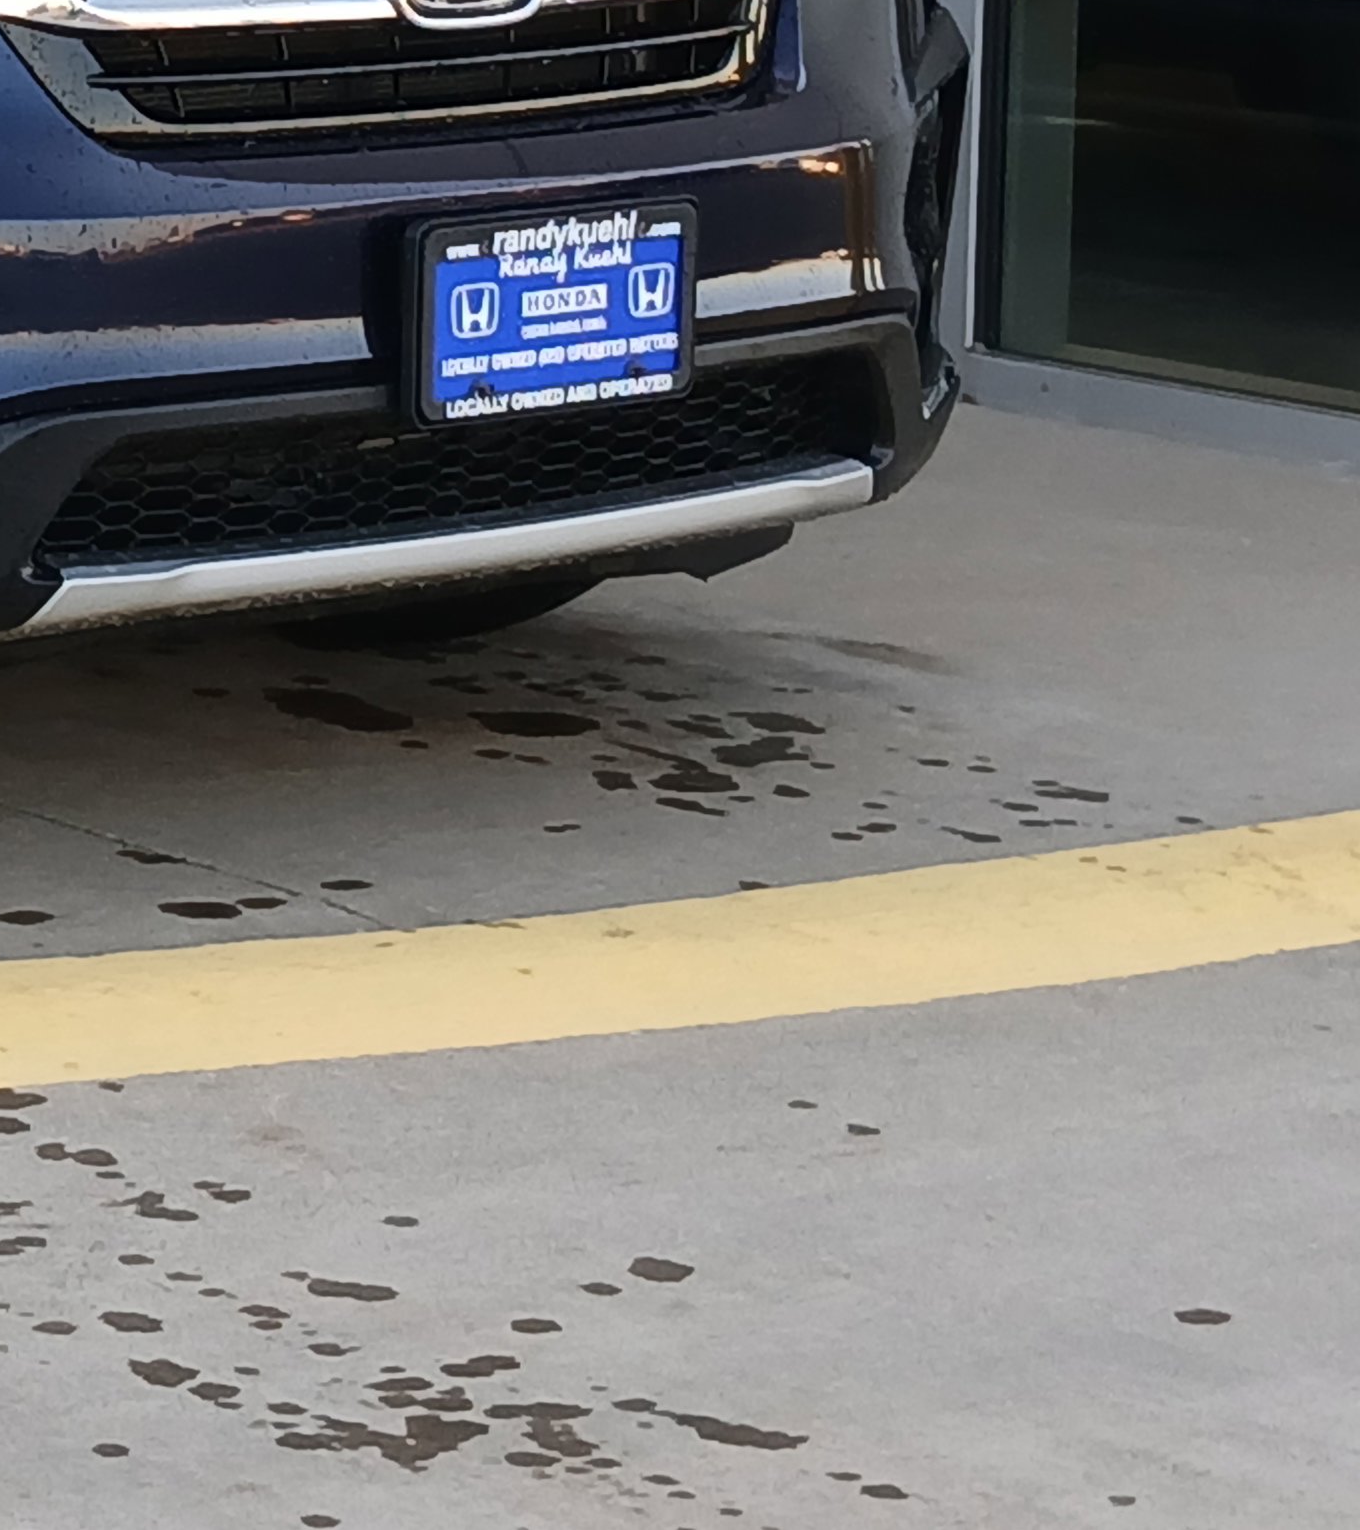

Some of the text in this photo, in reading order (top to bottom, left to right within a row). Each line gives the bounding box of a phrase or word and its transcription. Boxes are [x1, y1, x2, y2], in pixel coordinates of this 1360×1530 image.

[498, 252, 568, 284] Randy
[574, 240, 632, 270] Kuehl
[527, 288, 602, 312] HONDA
